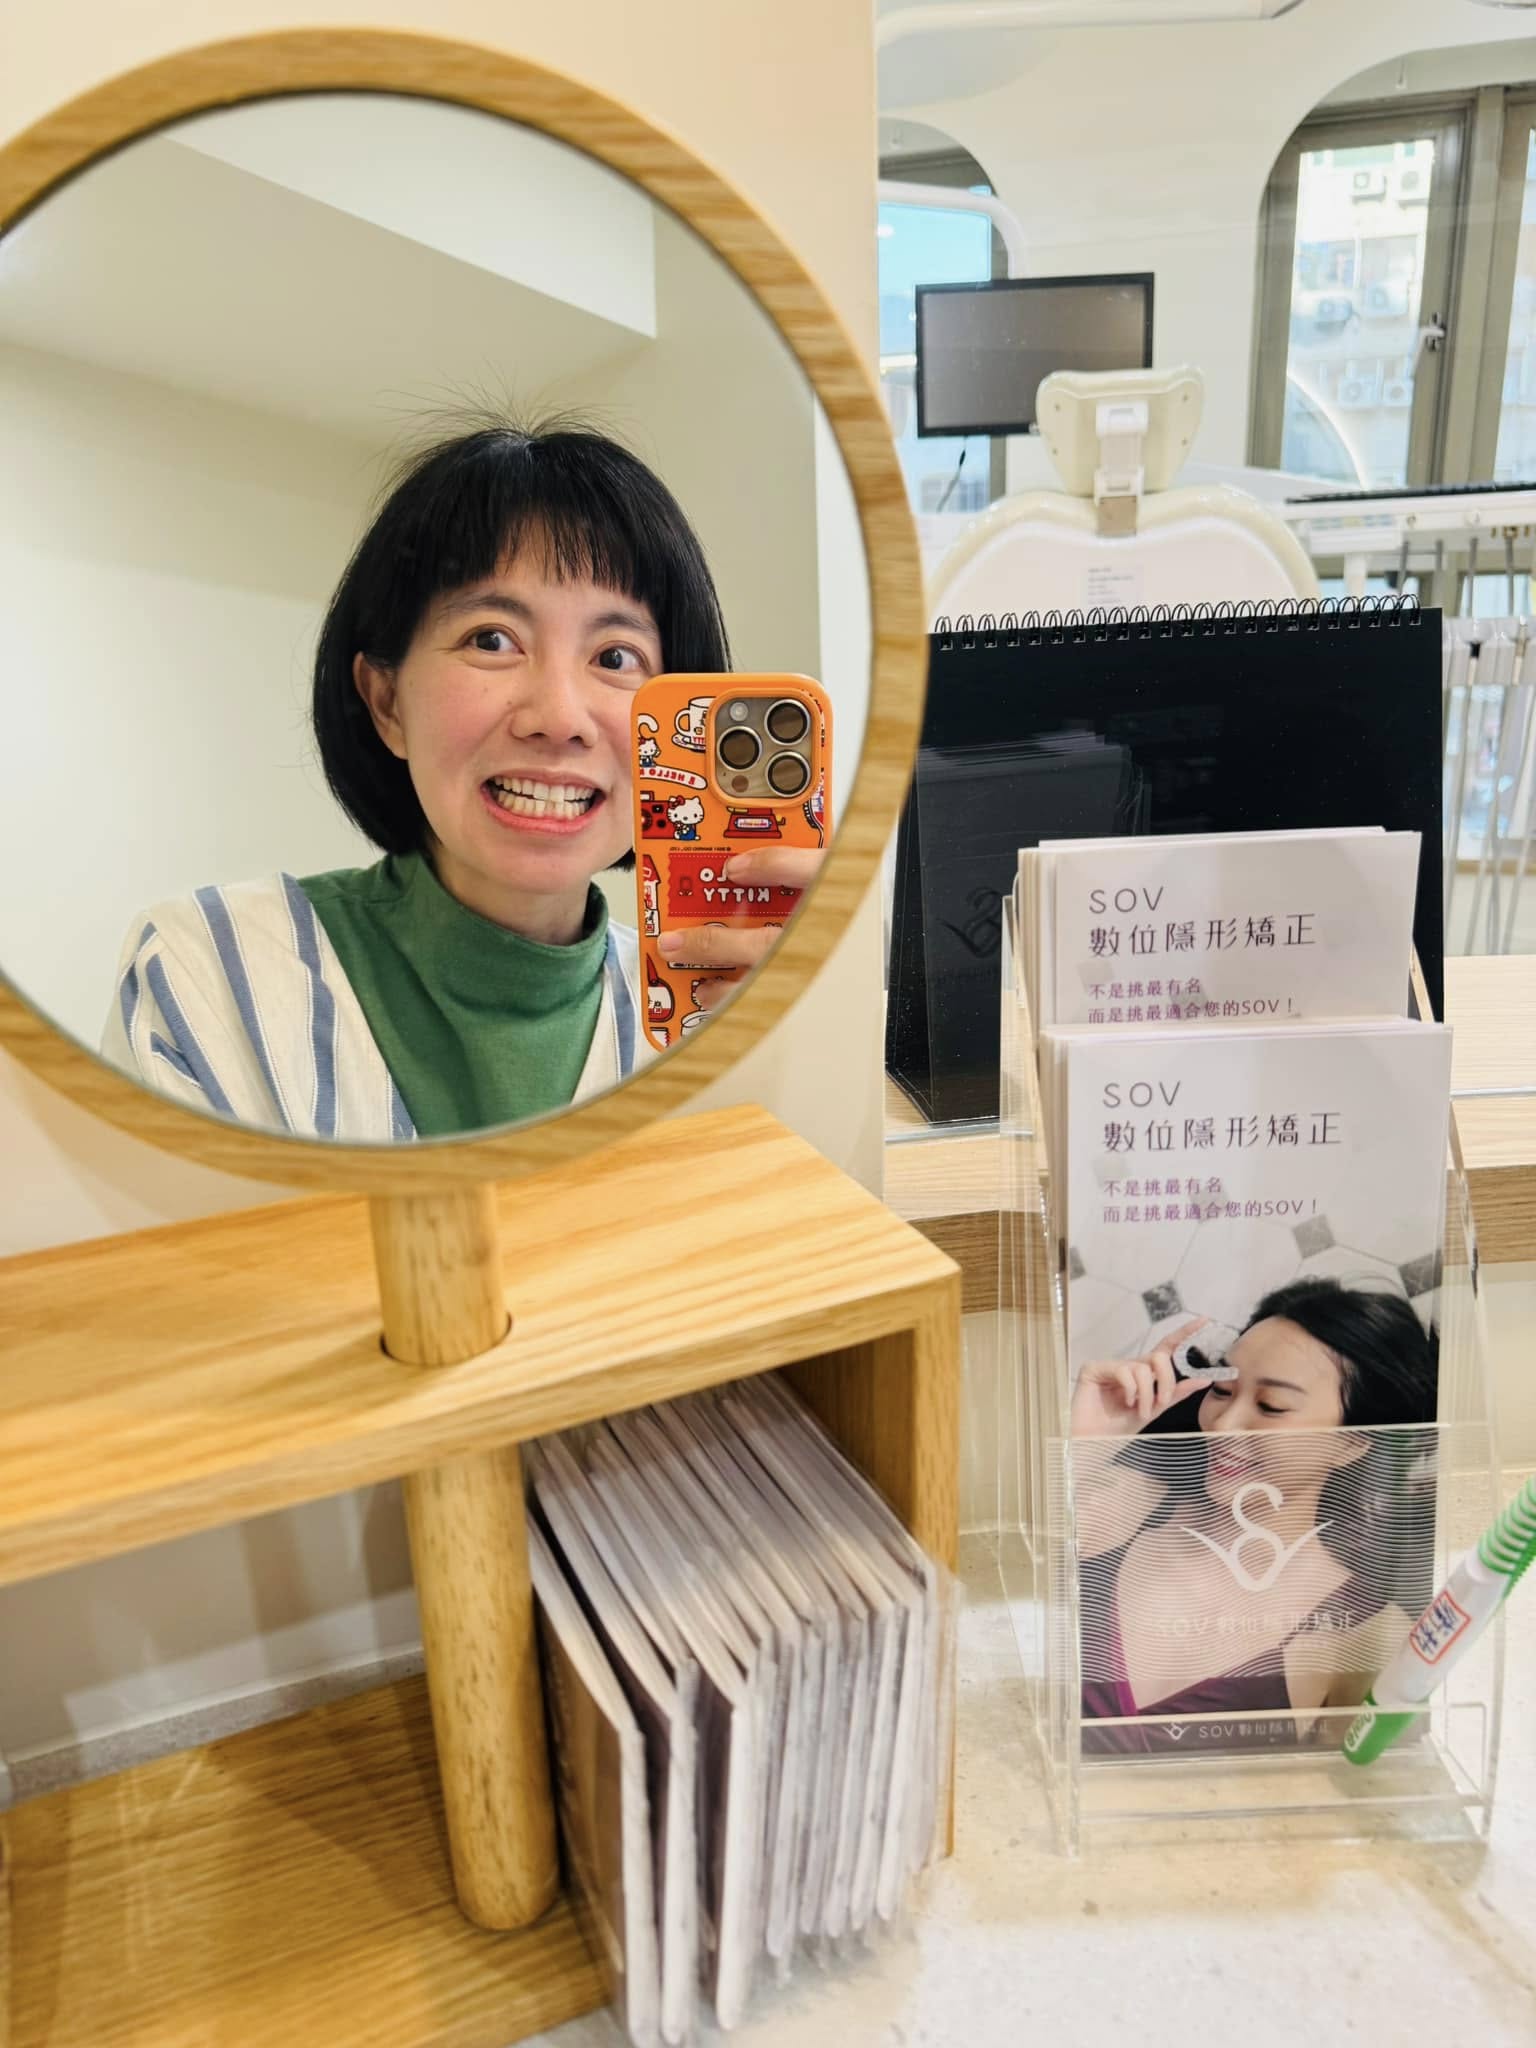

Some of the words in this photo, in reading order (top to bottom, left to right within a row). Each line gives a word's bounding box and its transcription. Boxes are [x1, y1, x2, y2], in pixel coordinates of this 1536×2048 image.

[1089, 886, 1164, 914] SOV
[1088, 913, 1316, 957] 數位隱形矯正
[1089, 977, 1202, 1000] 不是挑最有名
[1102, 1080, 1181, 1109] SOV
[1101, 1112, 1342, 1153] 數位隱形矯正
[1103, 1176, 1223, 1198] 不是挑最有名
